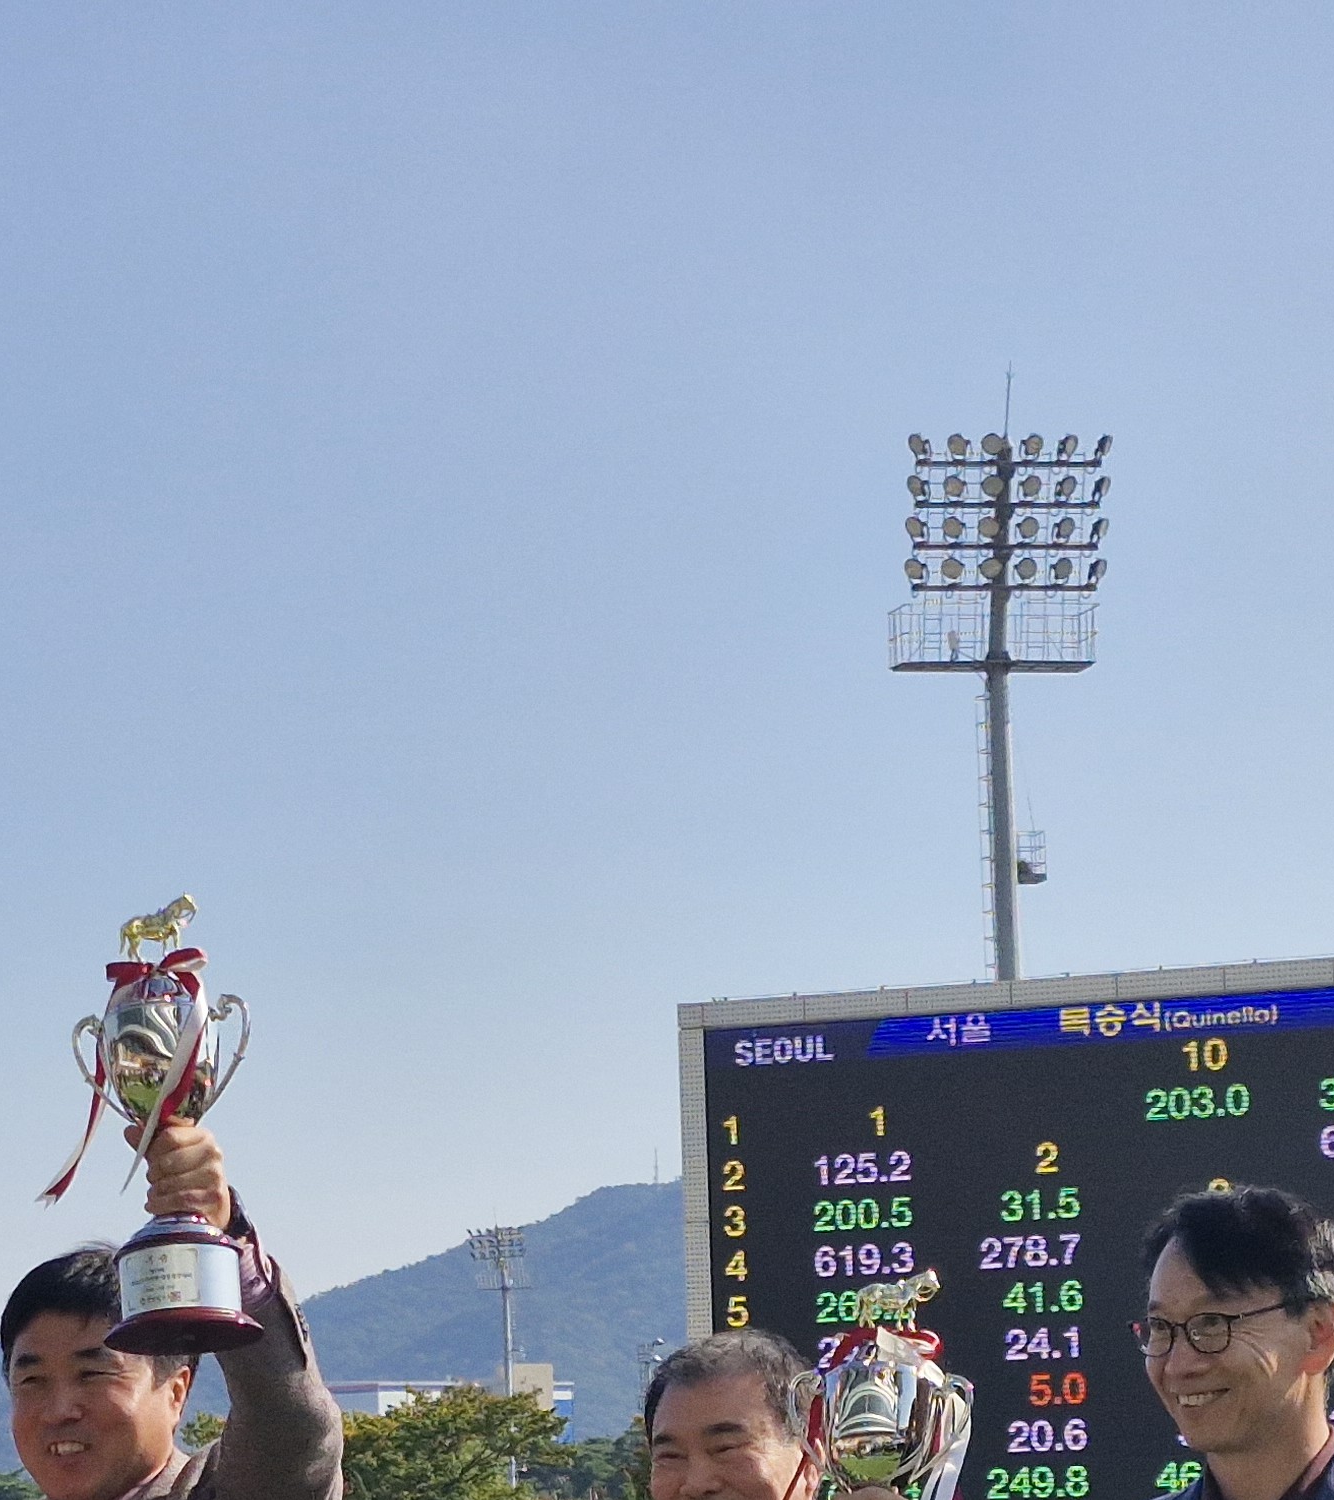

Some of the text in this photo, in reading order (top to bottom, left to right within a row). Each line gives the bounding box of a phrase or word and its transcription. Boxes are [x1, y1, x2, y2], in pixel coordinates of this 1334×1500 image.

[926, 1013, 992, 1046] 서울
[734, 1036, 835, 1066] SEOUL
[1182, 1038, 1227, 1071] 10
[1146, 1084, 1249, 1120] 203.0
[723, 1116, 737, 1144] 1
[870, 1106, 884, 1136] 1
[723, 1161, 745, 1191] 2
[815, 1151, 911, 1185] 125.2
[1036, 1142, 1058, 1173] 2
[724, 1206, 746, 1236] 3
[814, 1197, 912, 1231] 200.5
[1001, 1187, 1080, 1221] 31.5
[725, 1250, 747, 1281] 4
[815, 1242, 914, 1277] 619.3
[980, 1234, 1080, 1269] 278.7
[727, 1296, 748, 1327] 5
[1003, 1280, 1083, 1313] 41.6
[1005, 1327, 1079, 1360] 24.1
[1030, 1372, 1086, 1406] 5.0
[1008, 1419, 1087, 1452] 20.6
[987, 1466, 1089, 1499] 249.8
